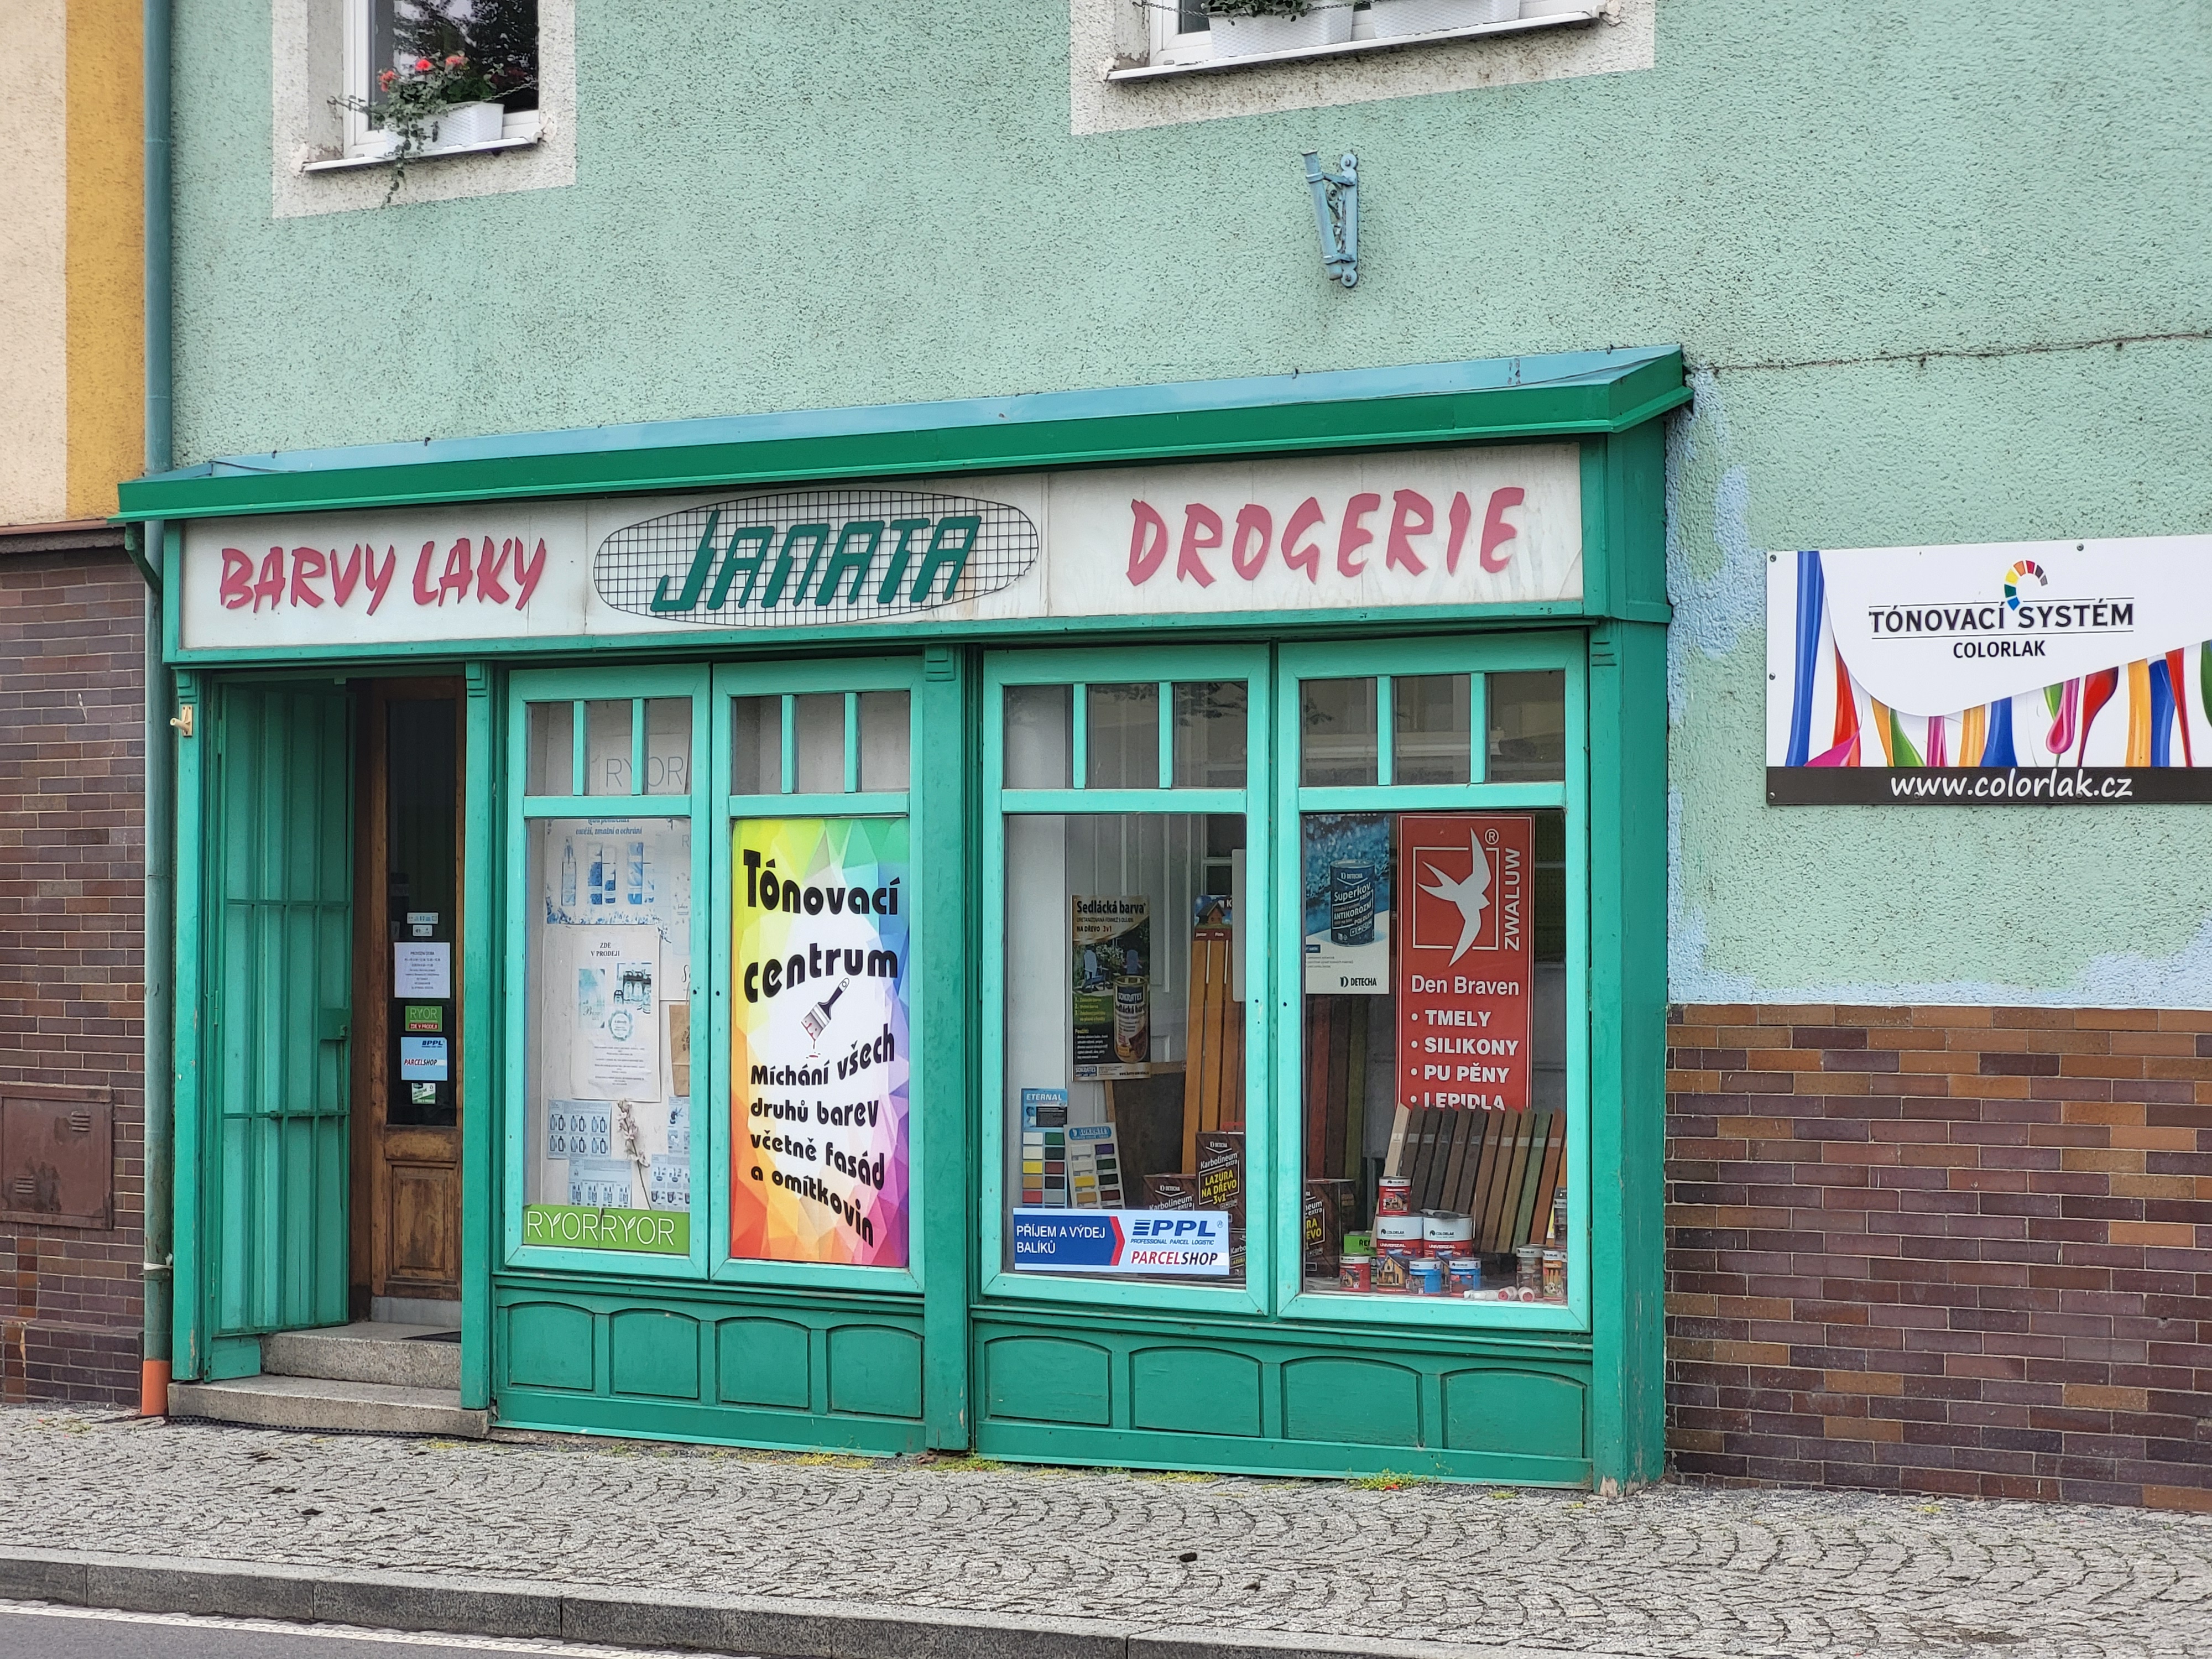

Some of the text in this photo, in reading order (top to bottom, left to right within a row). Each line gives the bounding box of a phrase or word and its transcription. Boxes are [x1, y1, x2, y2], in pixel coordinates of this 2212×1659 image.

[1125, 487, 1525, 589] DROGERIE
[650, 509, 982, 612] JANATA
[220, 536, 546, 617] BARVY LAKY
[1869, 598, 2134, 634] TÓNOVACÍ SYSTÉM
[1953, 640, 2046, 659] COLORLAK
[1890, 768, 2133, 799] www.colorlak.cz
[743, 849, 900, 916] Tónovací
[1334, 882, 1371, 902] Superkov
[1077, 900, 1144, 914] Sedlácká barva
[1504, 847, 1521, 951] ZWALUW
[743, 942, 898, 1004] centrum
[1350, 977, 1377, 987] DETECHA
[1412, 974, 1520, 996] Den Braven
[410, 1008, 437, 1019] RYOR
[1425, 1009, 1491, 1027] TMELY
[750, 1023, 895, 1086] Míchání všech
[1424, 1036, 1519, 1056] SILIKONY
[1424, 1062, 1510, 1084] PU PĚNY
[750, 1098, 879, 1128] druhů barev
[750, 1129, 885, 1191] včetně fasád
[1200, 1152, 1238, 1170] Karbolineum
[1225, 1159, 1238, 1167] extra
[1204, 1169, 1234, 1186] LAZURA
[1201, 1179, 1237, 1198] NA DŘEVO
[750, 1166, 874, 1248] a omítkovin
[1149, 1196, 1192, 1210] Karbolineum
[1177, 1202, 1192, 1211] extra
[1213, 1194, 1227, 1205] 3v1
[1308, 1207, 1322, 1216] extra
[526, 1211, 675, 1246] RYOR RYOR
[1016, 1223, 1105, 1239] PŘÍJEM A VÝDEJ
[1151, 1220, 1216, 1237] PPL
[1017, 1240, 1056, 1254] BALÍKŮ
[1131, 1251, 1218, 1265] PARCELSHOP
